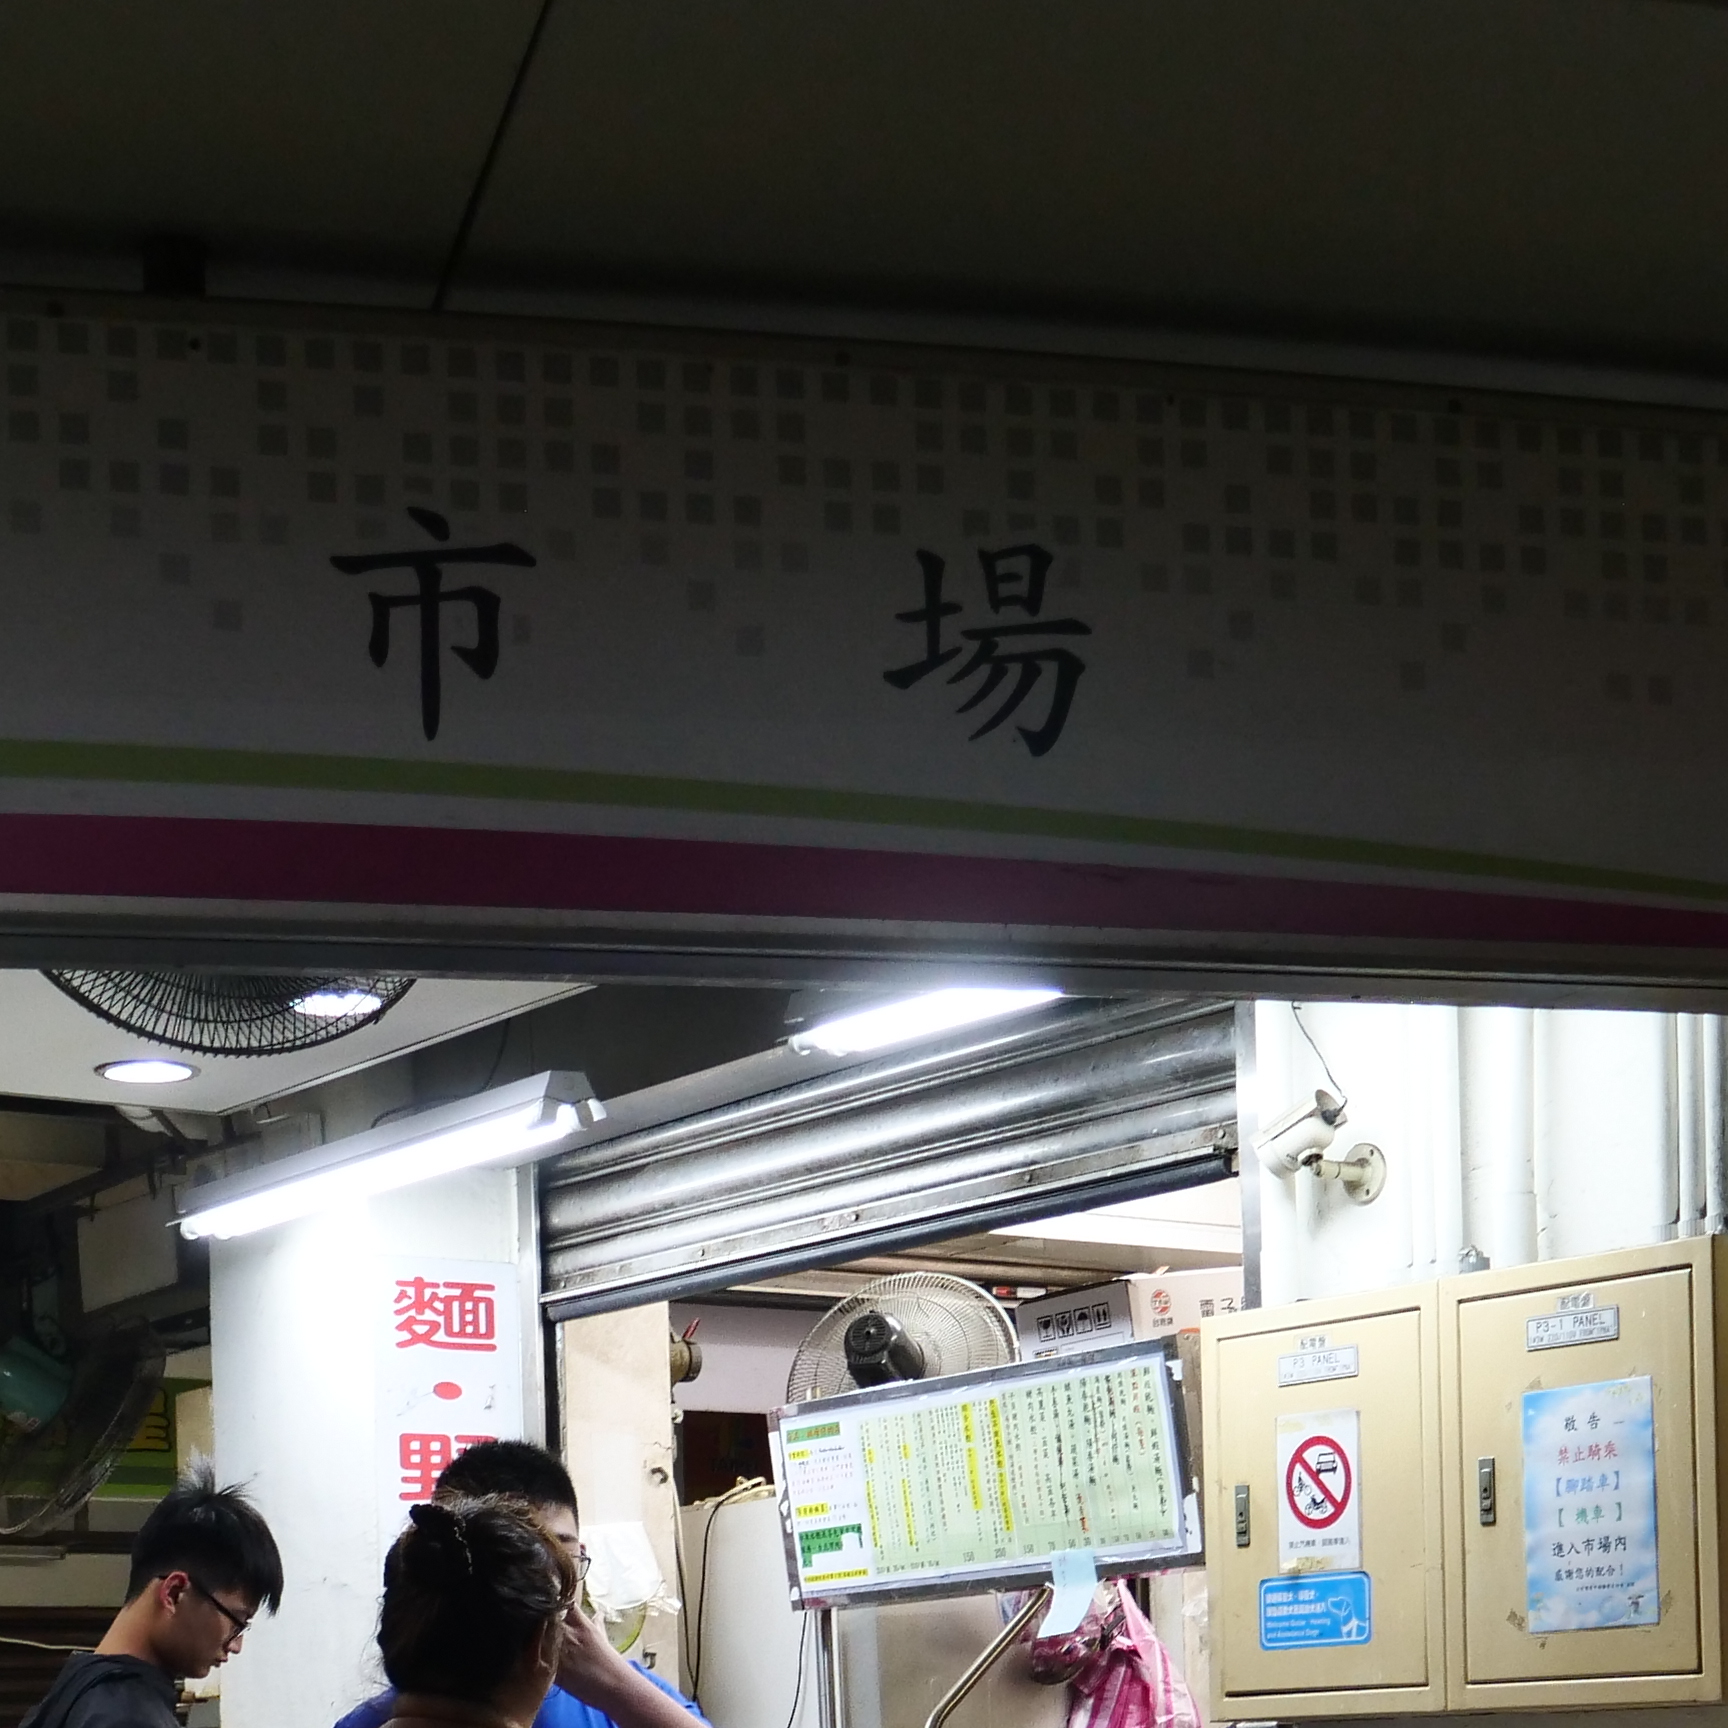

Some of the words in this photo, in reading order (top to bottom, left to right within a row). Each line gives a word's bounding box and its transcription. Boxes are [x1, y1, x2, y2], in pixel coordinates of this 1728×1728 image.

[1536, 1318, 1563, 1333] P3-1
[1573, 1313, 1606, 1328] PANEL
[1312, 1352, 1340, 1366] PANEL
[1557, 1440, 1618, 1467] 禁止騎乘
[1552, 1535, 1627, 1558] 進入市場內
